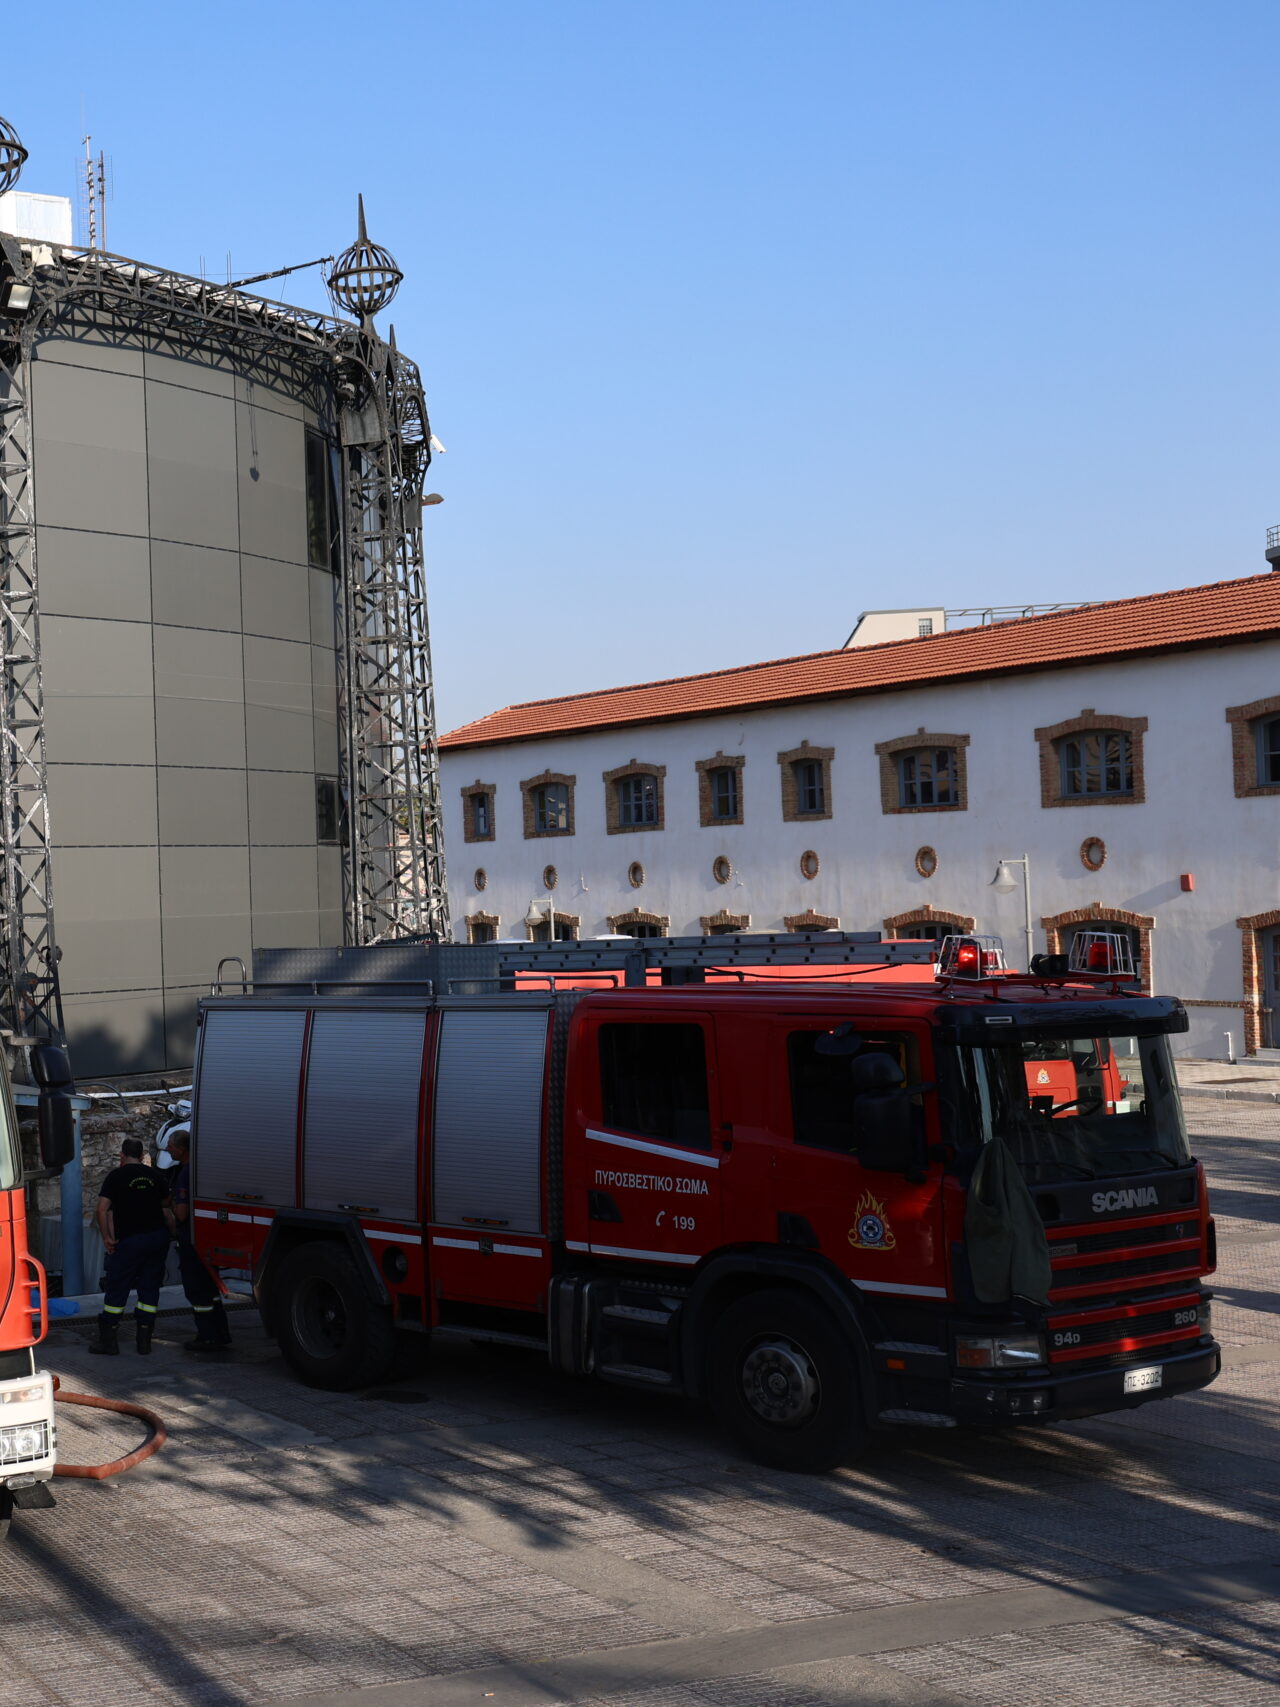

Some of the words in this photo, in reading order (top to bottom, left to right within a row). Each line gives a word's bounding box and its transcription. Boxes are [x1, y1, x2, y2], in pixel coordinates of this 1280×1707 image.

[595, 1169, 673, 1192] ΠΥΡΟΣΒΕΣΤΙΚΟ
[675, 1177, 709, 1195] ΣΩΜΑ
[1092, 1186, 1159, 1213] SCANIA
[672, 1216, 696, 1230] 199
[1174, 1309, 1197, 1325] 260
[1054, 1332, 1081, 1346] 94D
